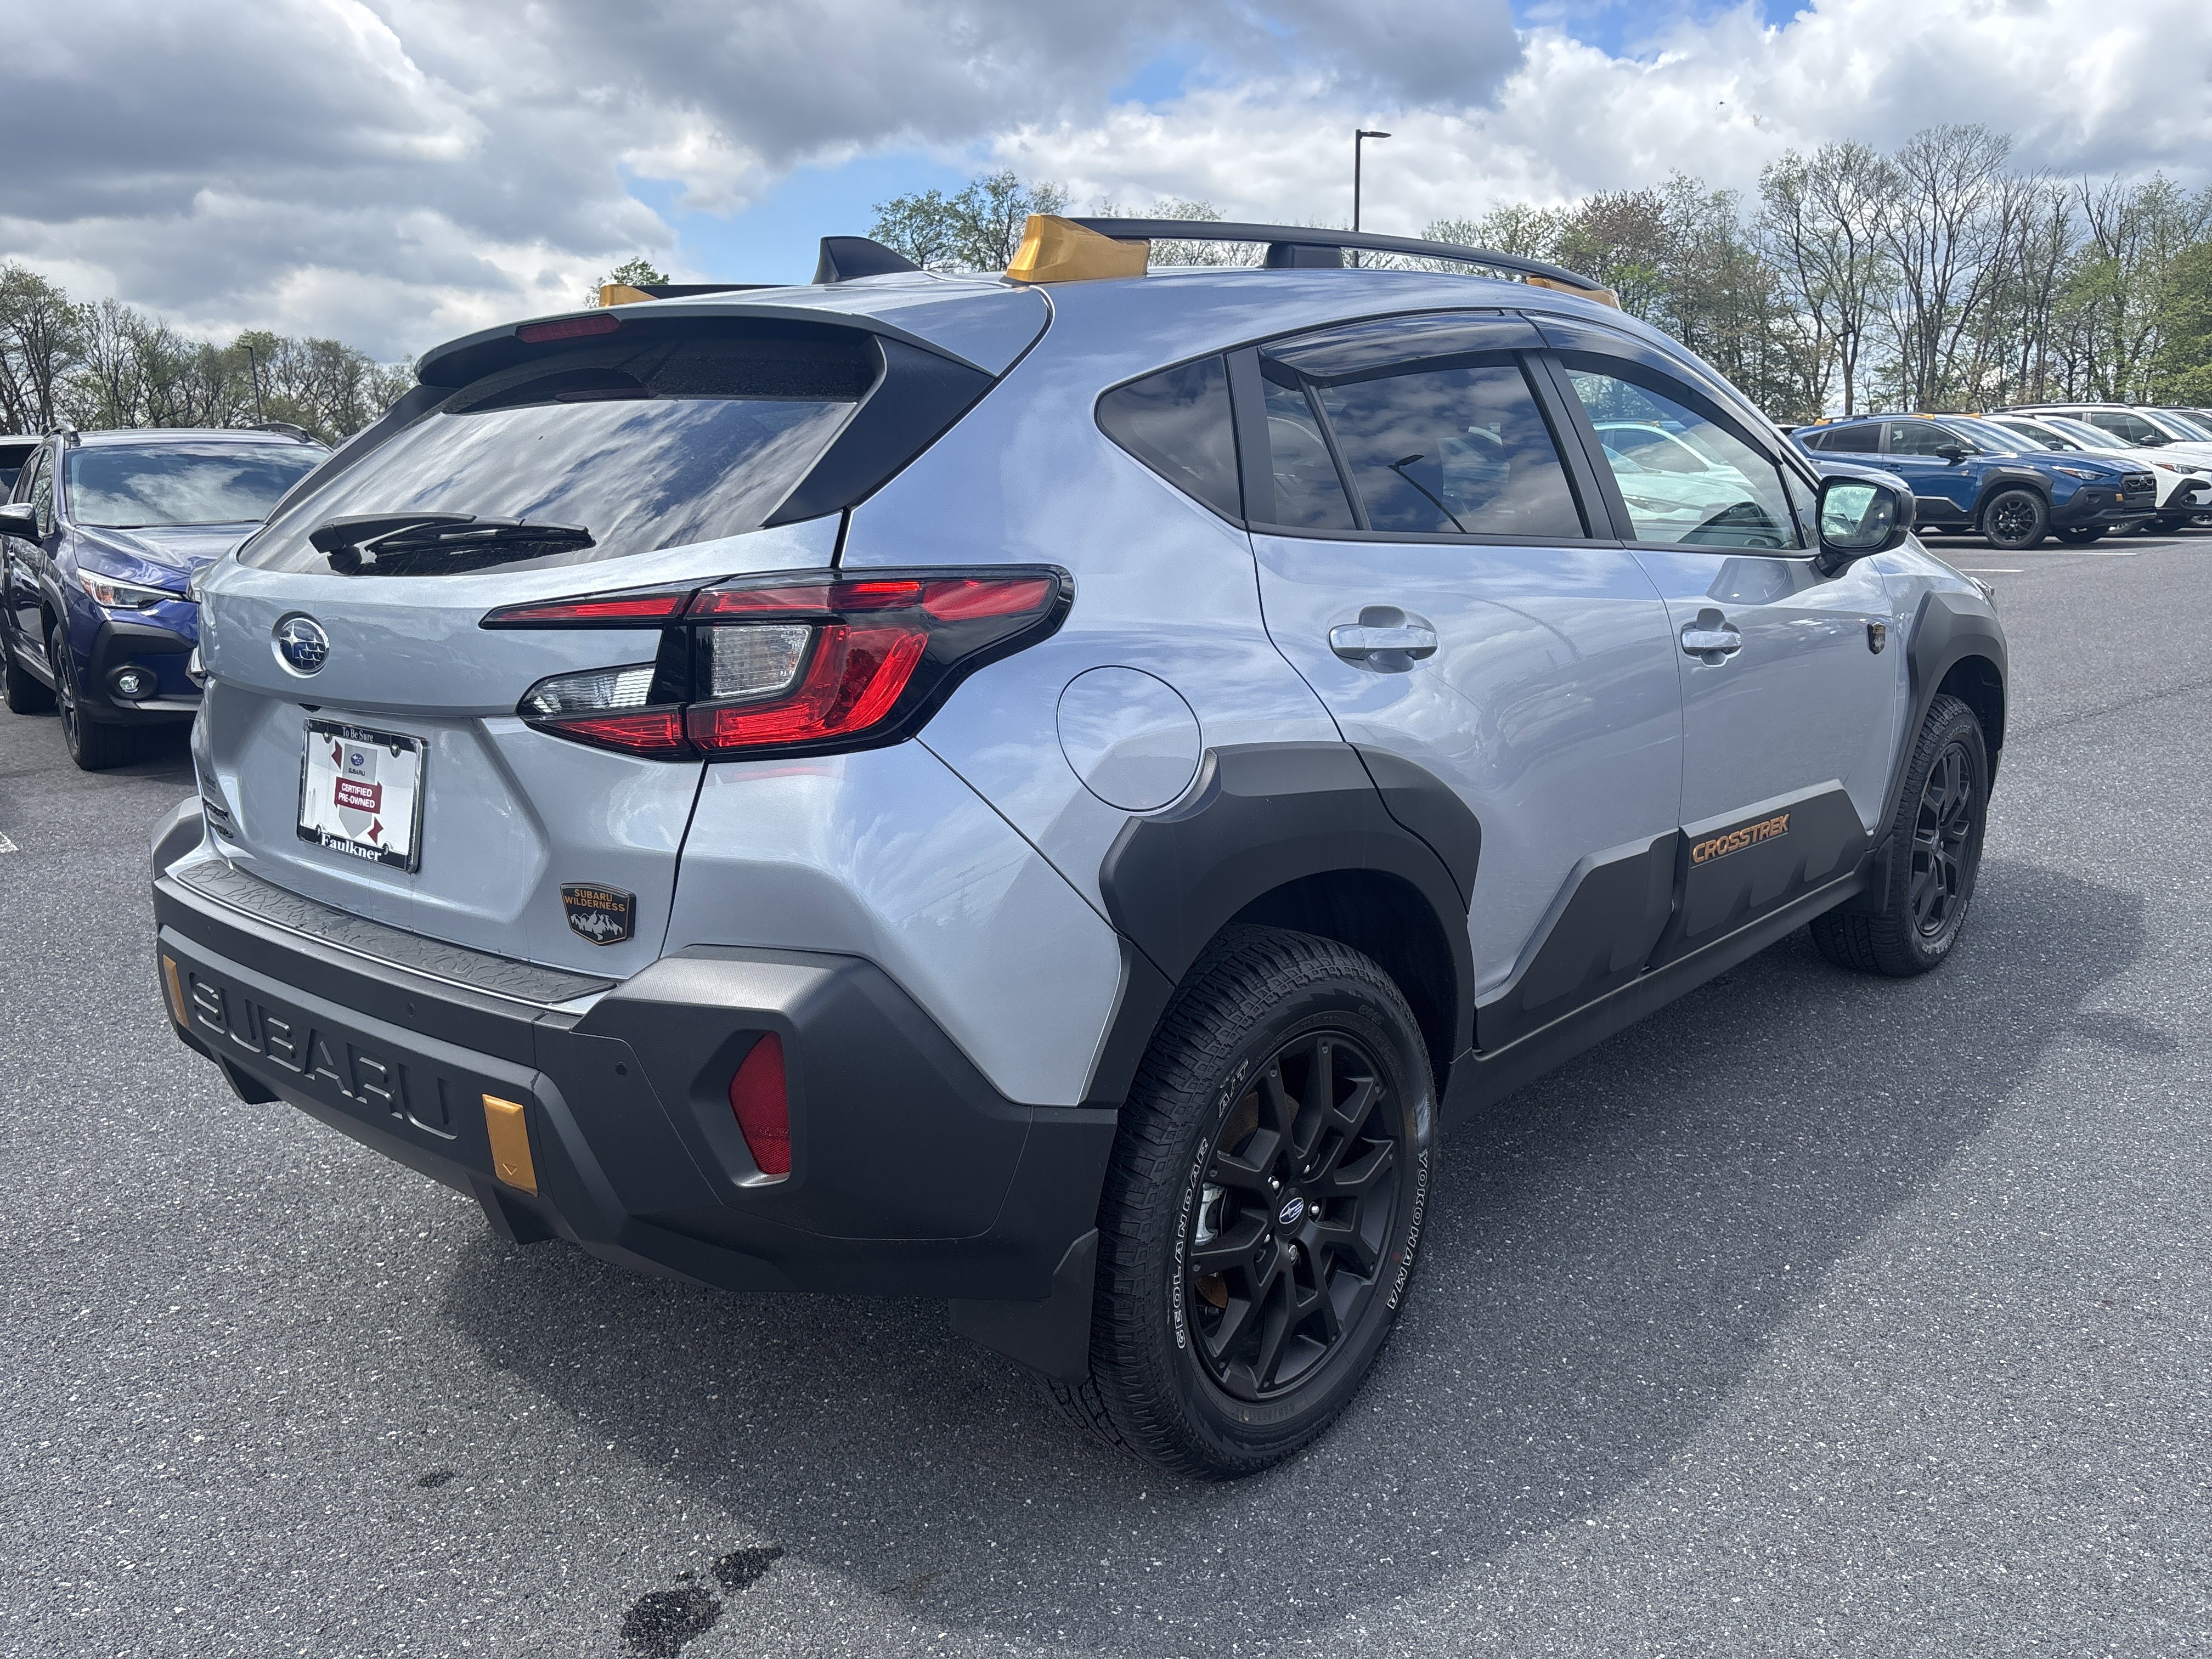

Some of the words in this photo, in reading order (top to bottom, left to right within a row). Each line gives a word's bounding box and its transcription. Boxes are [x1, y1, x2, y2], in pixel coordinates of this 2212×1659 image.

[342, 727, 349, 737] To
[351, 729, 358, 738] Be
[359, 731, 374, 742] Sure
[348, 768, 366, 776] SUBARU
[341, 782, 373, 797] CERTIFIED
[338, 793, 375, 809] PRE-OWNED
[320, 832, 382, 861] Faulkner
[1692, 813, 1790, 864] CROSSTREK
[564, 895, 625, 912] WILDERNESS
[574, 889, 613, 902] SUBARU
[189, 971, 459, 1141] SUBARU
[1386, 1148, 1428, 1310] YOKOHAMA
[1172, 1136, 1209, 1349] GEOLANDAR
